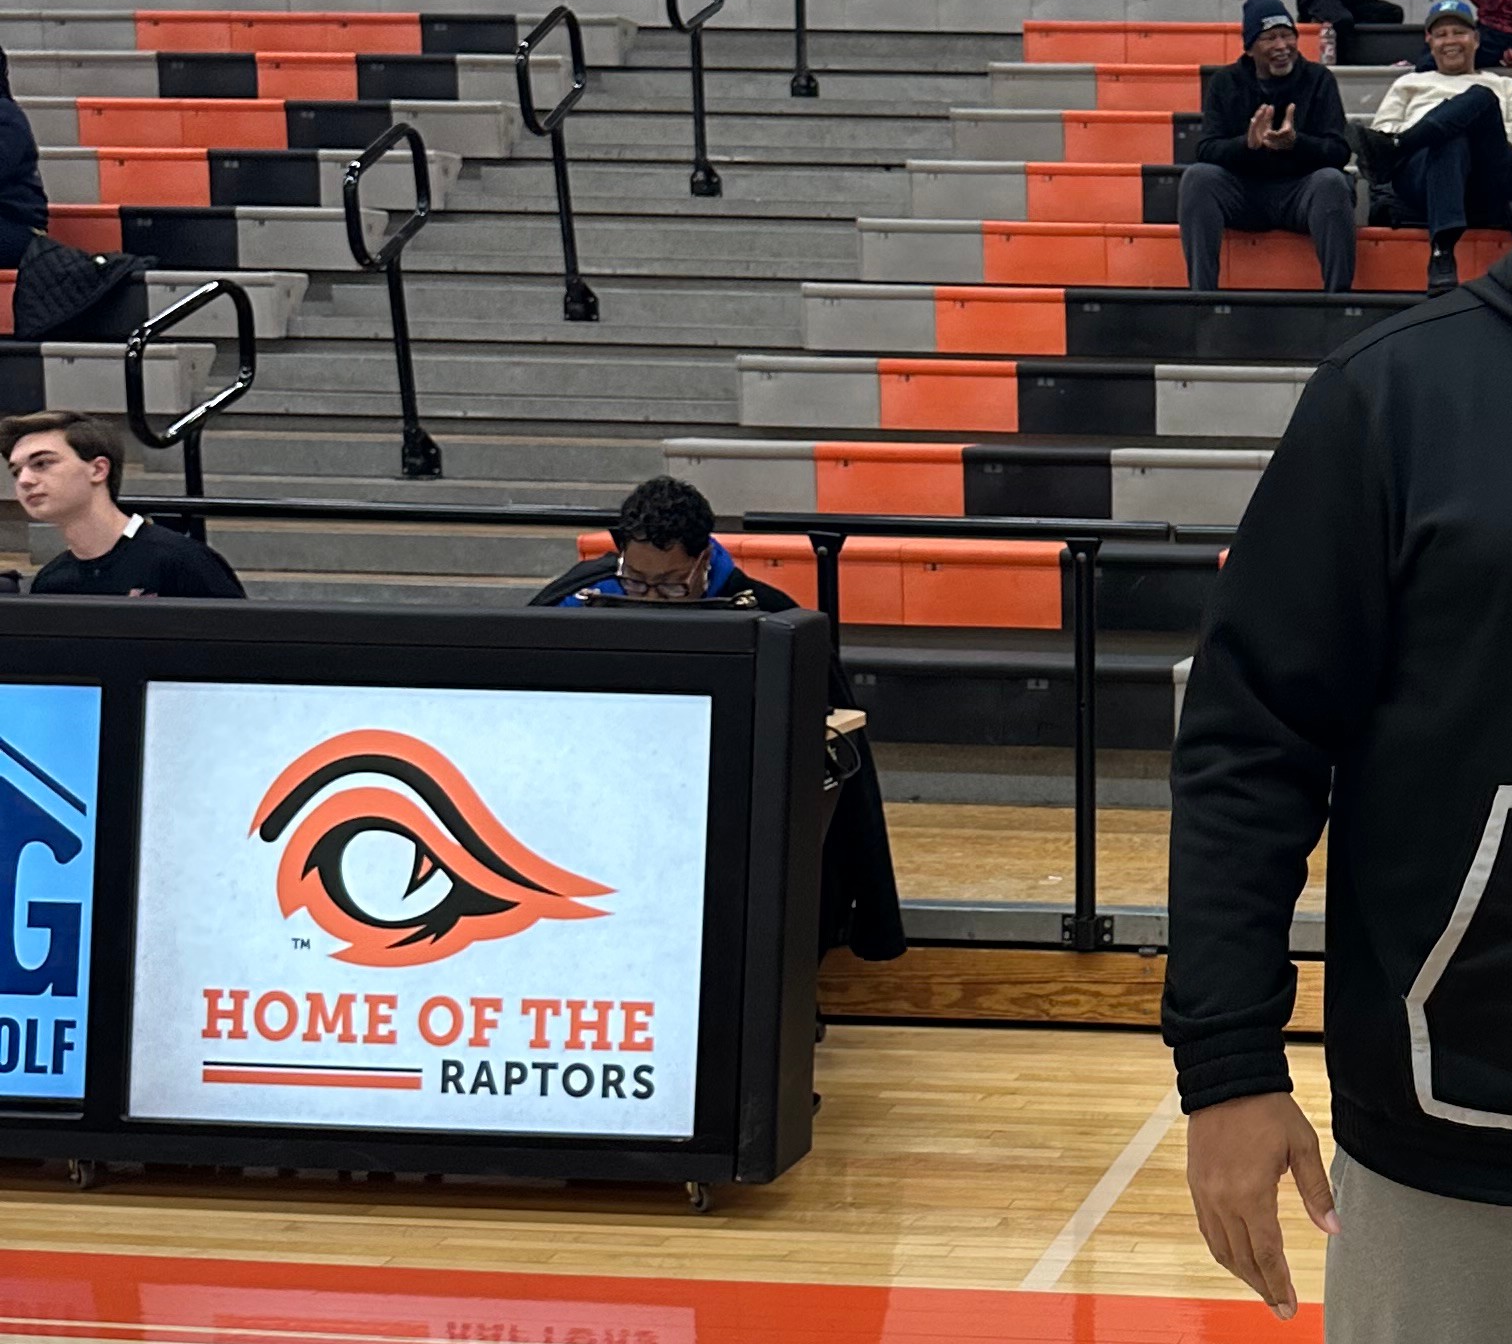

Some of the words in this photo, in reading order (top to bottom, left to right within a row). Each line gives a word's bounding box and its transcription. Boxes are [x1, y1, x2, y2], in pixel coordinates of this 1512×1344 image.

[292, 937, 311, 950] TM
[201, 988, 397, 1045] HOME
[418, 995, 503, 1047] OF
[521, 998, 655, 1052] THE
[440, 1058, 655, 1100] RAPTORS
